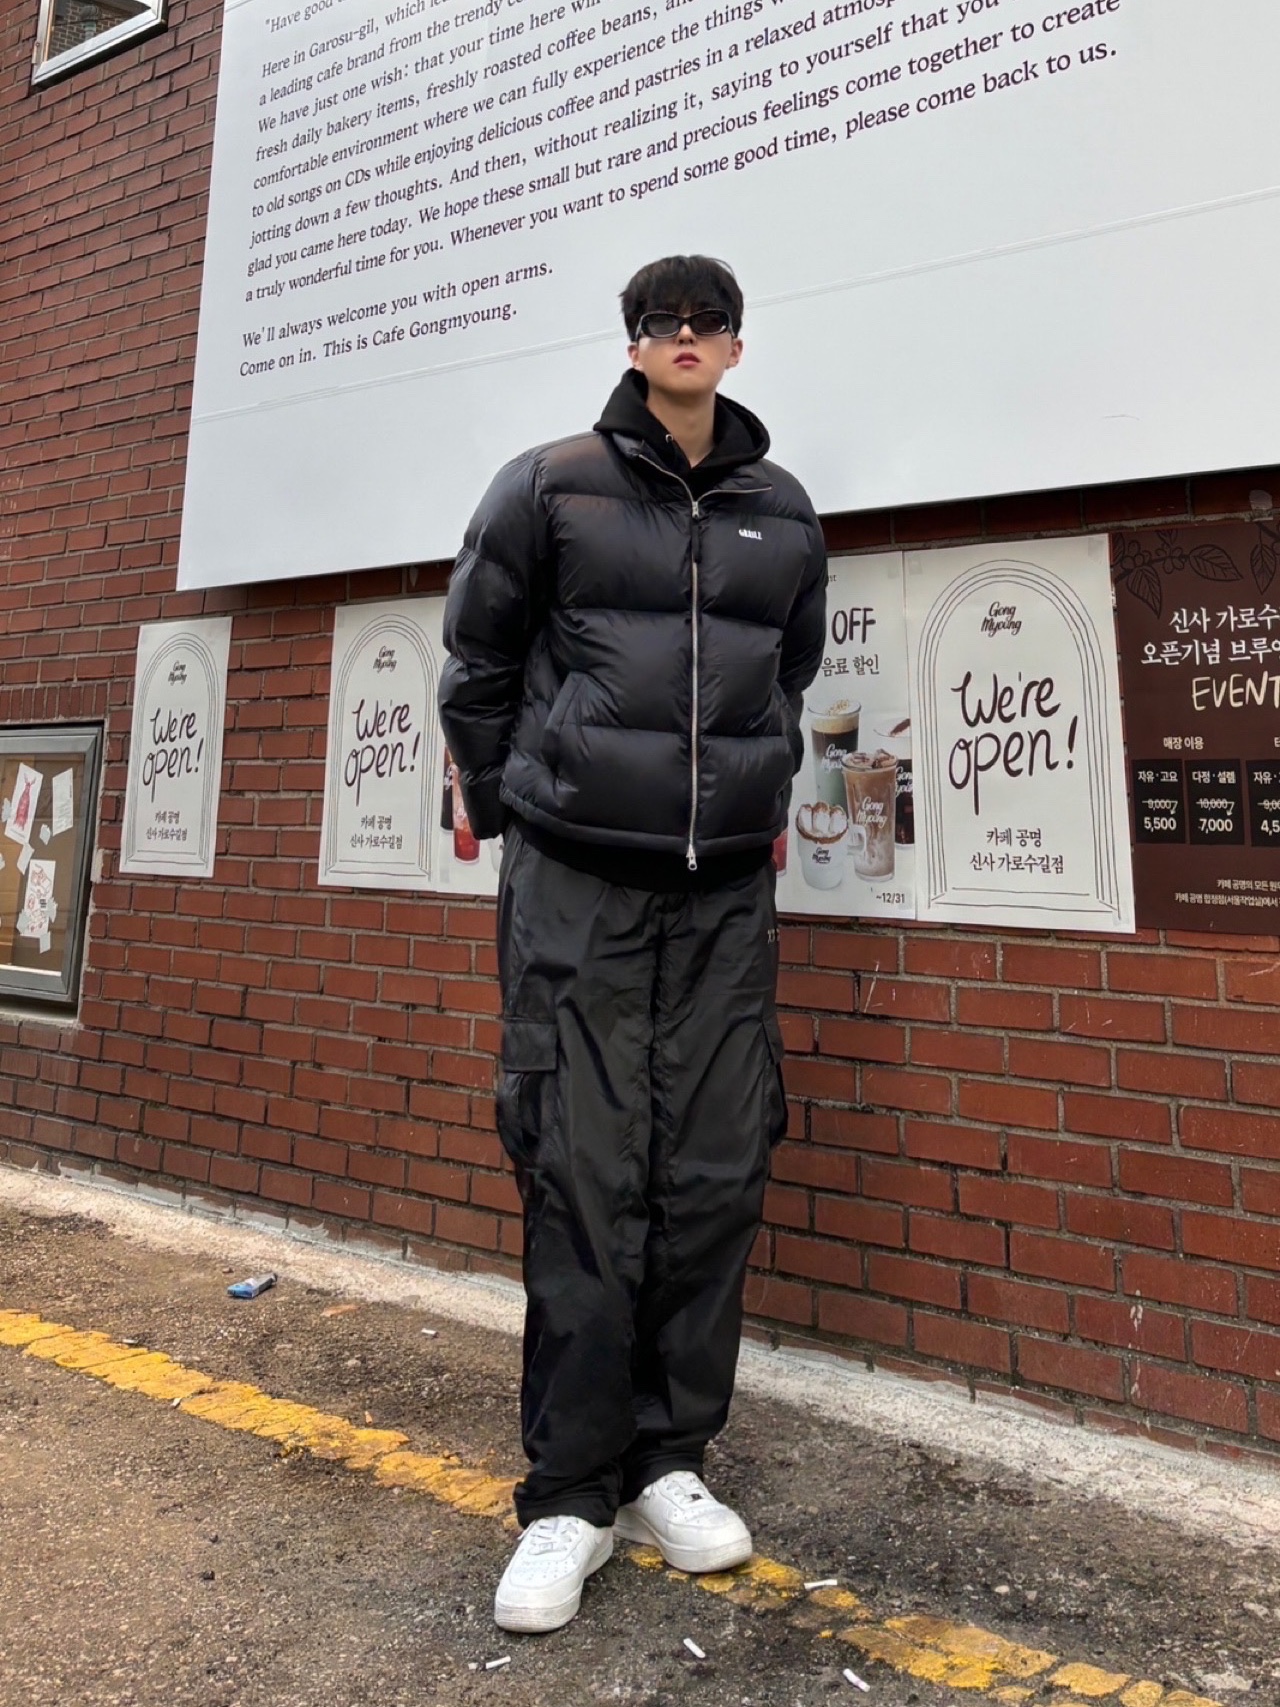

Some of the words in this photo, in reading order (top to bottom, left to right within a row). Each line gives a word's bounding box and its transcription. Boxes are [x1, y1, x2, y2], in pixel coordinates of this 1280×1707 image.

[258, 93, 266, 105] a
[269, 74, 313, 101] leading
[316, 60, 343, 82] cafe
[346, 41, 384, 70] brand
[389, 30, 421, 54] from
[426, 19, 450, 38] the
[453, 0, 502, 27] trendy
[258, 115, 276, 132] We
[279, 104, 309, 125] have
[312, 92, 338, 116] just
[342, 82, 366, 101] one
[370, 63, 408, 89] wish:
[414, 50, 444, 73] that
[449, 36, 484, 64] your
[488, 21, 524, 45] time
[529, 5, 565, 30] here
[261, 56, 290, 77] Here
[293, 49, 305, 64] in
[308, 17, 378, 57] Garosu-gil,
[384, 0, 425, 25] which
[251, 203, 264, 217] to
[266, 193, 284, 212] old
[287, 184, 322, 206] songs
[325, 178, 341, 193] on
[344, 167, 371, 187] CDs
[374, 153, 410, 176] while
[414, 133, 474, 164] enjoying
[477, 111, 542, 144] delicious
[547, 93, 594, 121] coffee
[598, 76, 630, 104] and
[634, 56, 701, 96] pastries
[706, 47, 723, 66] in
[727, 42, 739, 58] a
[744, 8, 816, 52] relaxed
[253, 152, 328, 189] comfortable
[331, 121, 418, 163] environment
[422, 104, 468, 130] where
[472, 95, 494, 113] we
[498, 84, 526, 105] can
[532, 68, 568, 94] fully
[572, 34, 665, 79] experience
[670, 20, 699, 43] the
[704, 0, 763, 30] things
[255, 137, 287, 161] fresh
[291, 126, 322, 148] daily
[326, 109, 372, 135] bakery
[376, 93, 419, 118] items,
[426, 69, 478, 99] freshly
[483, 42, 541, 79] roasted
[546, 26, 595, 55] coffee
[601, 4, 657, 35] beans,
[247, 252, 272, 277] glad
[274, 249, 297, 269] you
[300, 238, 334, 258] came
[337, 228, 366, 248] here
[369, 216, 412, 238] today.
[418, 205, 440, 223] We
[443, 195, 479, 217] hope
[482, 182, 524, 205] these
[528, 163, 570, 193] small
[574, 157, 602, 178] but
[607, 146, 642, 169] rare
[646, 130, 678, 158] and
[682, 109, 757, 150] precious
[762, 84, 839, 121] feelings
[845, 64, 901, 95] come
[907, 30, 1003, 75] together
[1009, 21, 1034, 42] to
[1041, 0, 1120, 32] create
[248, 222, 291, 249] jotting
[294, 210, 329, 231] down
[332, 206, 341, 220] a
[345, 198, 370, 216] few
[374, 177, 442, 207] thoughts.
[449, 159, 479, 184] And
[484, 151, 526, 173] then,
[533, 125, 597, 157] without
[603, 99, 677, 136] realizing
[683, 91, 703, 110] it,
[710, 67, 772, 100] saying
[778, 59, 799, 77] to
[805, 20, 893, 74] yourself
[900, 6, 949, 37] that
[245, 289, 252, 302] a
[255, 278, 285, 298] truly
[288, 258, 352, 289] wonderful
[355, 252, 385, 272] time
[389, 245, 410, 262] for
[413, 238, 443, 260] you.
[450, 214, 526, 245] Whenever
[529, 205, 558, 229] you
[562, 191, 603, 215] want
[607, 186, 625, 203] to
[629, 165, 678, 199] spend
[683, 155, 729, 181] some
[733, 134, 778, 170] good
[783, 125, 836, 151] time,
[845, 101, 909, 139] please
[915, 81, 975, 113] come
[981, 58, 1039, 93] back
[1045, 53, 1070, 73] to
[1078, 41, 1116, 64] us.
[242, 325, 275, 346] We'll
[278, 317, 322, 338] always
[326, 301, 387, 326] welcome
[390, 293, 417, 314] you
[422, 280, 456, 303] with
[461, 273, 499, 295] open
[505, 261, 552, 284] arms.
[239, 357, 275, 376] Come
[278, 353, 294, 367] on
[298, 346, 316, 363] in.
[322, 336, 352, 357] This
[356, 333, 367, 349] is
[372, 324, 404, 346] Cafe
[409, 302, 516, 337] Gongmyoung.
[832, 608, 876, 645] OFF
[1170, 607, 1210, 633] 신사
[1217, 604, 1280, 632] 가로수
[821, 658, 849, 676] 음료
[853, 654, 879, 675] 할인
[1142, 639, 1220, 665] 오픈기념
[352, 699, 411, 738] We're
[951, 671, 1061, 727] We're
[1192, 671, 1280, 710] EVENT
[150, 708, 197, 745] We're
[143, 738, 204, 803] open!
[345, 733, 421, 806] open!
[949, 716, 1077, 815] open!
[350, 834, 364, 848] 신사
[987, 828, 1011, 846] 카페
[1016, 828, 1041, 847] 공명
[1144, 817, 1176, 832] 5,500
[1200, 819, 1233, 833] 7,000
[971, 852, 995, 871] 신사
[998, 853, 1063, 874] 가로수길점
